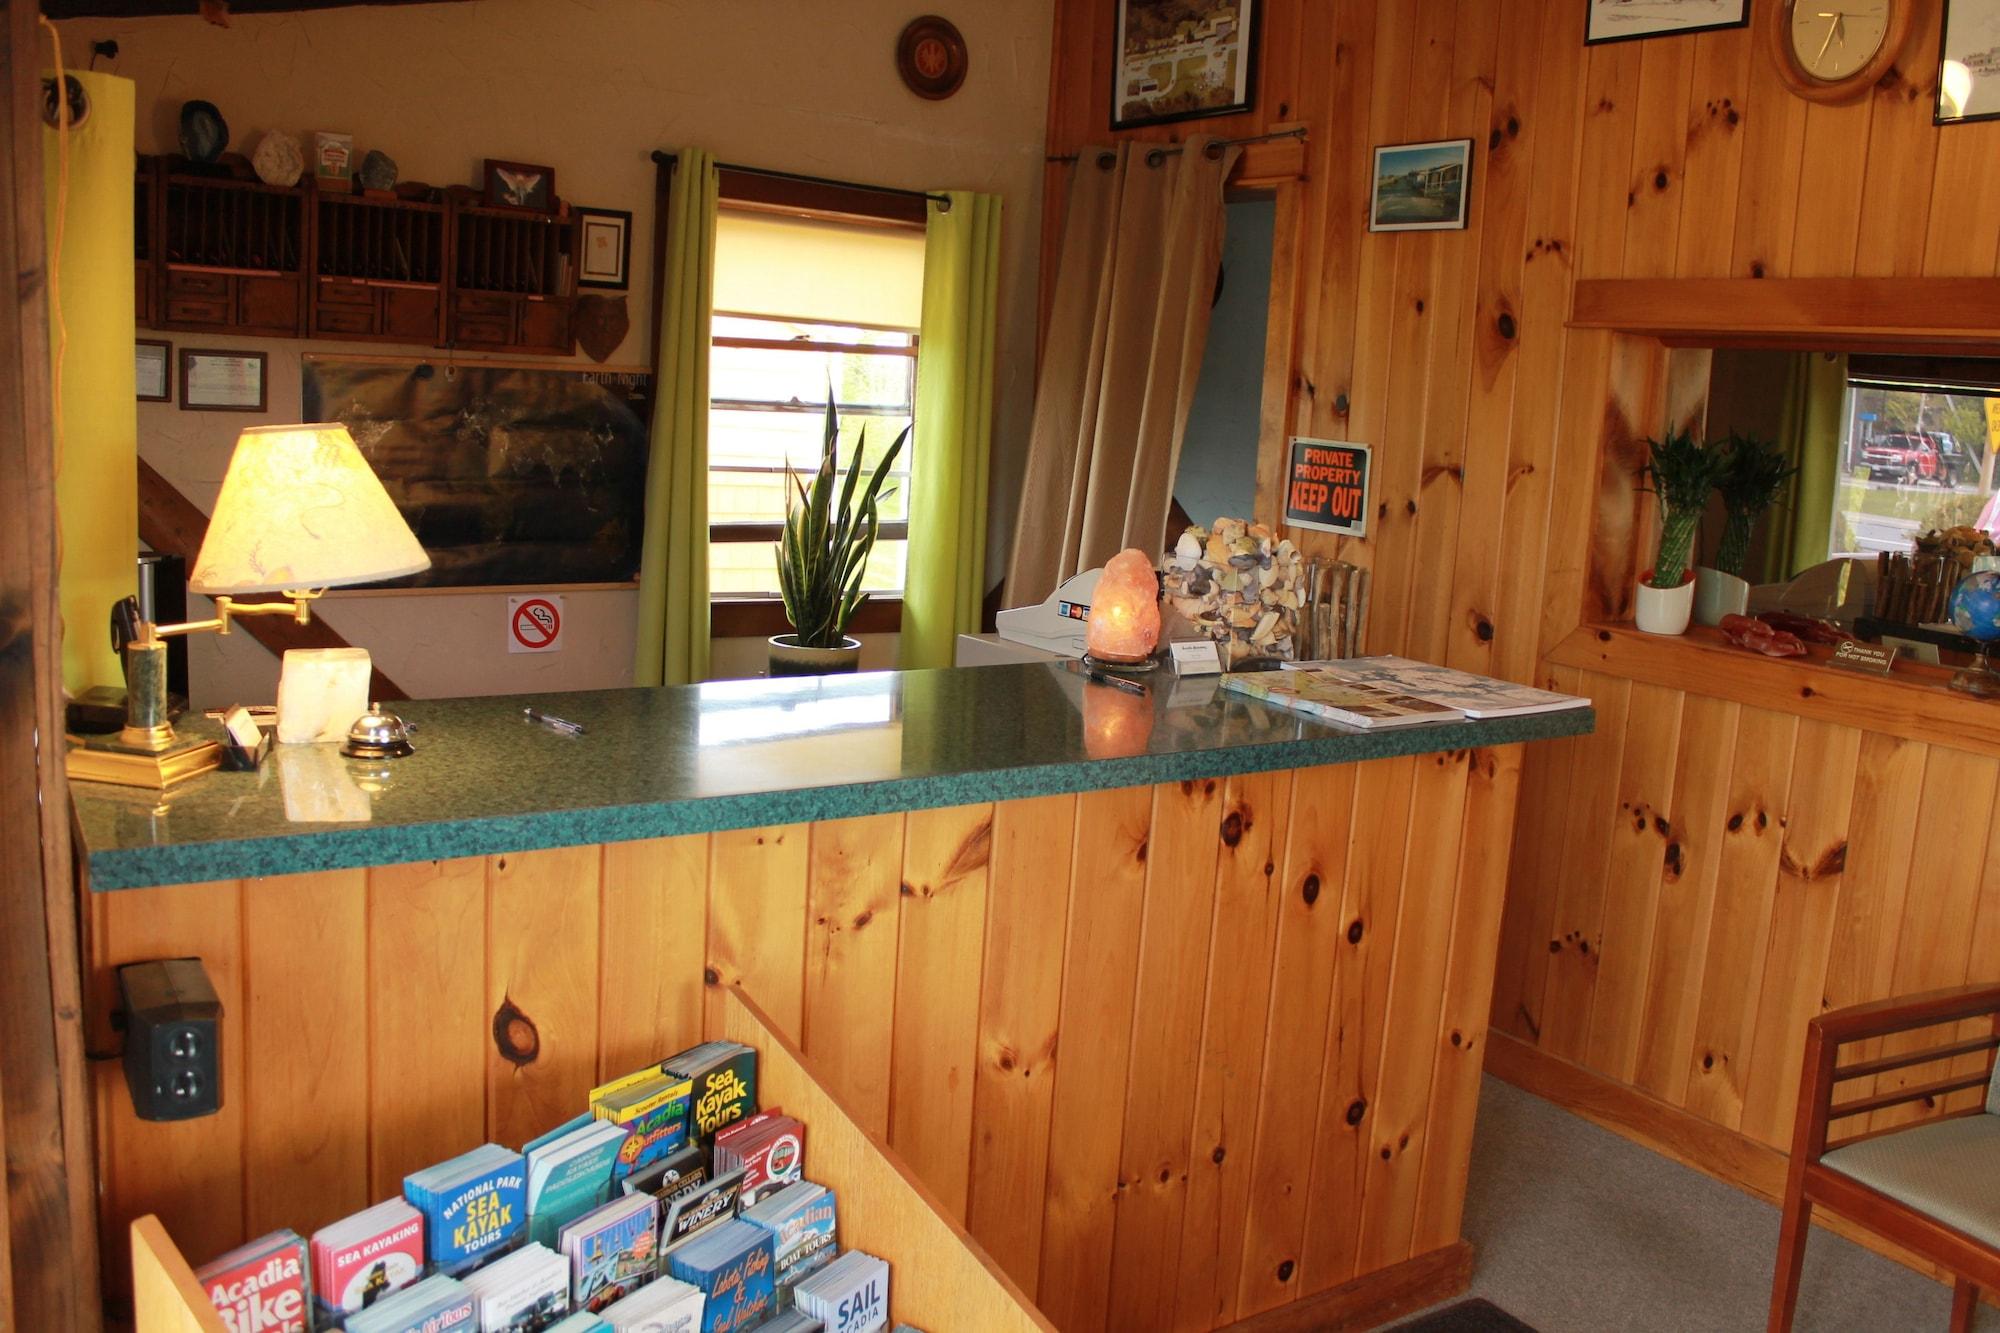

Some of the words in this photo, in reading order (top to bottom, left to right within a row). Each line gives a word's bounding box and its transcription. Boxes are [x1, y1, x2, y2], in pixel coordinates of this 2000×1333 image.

[1295, 463, 1361, 485] PROPERTY
[1304, 448, 1354, 467] PRIVATE
[1290, 481, 1328, 513] KEEP
[1332, 486, 1362, 518] OUT
[1835, 651, 1848, 659] FOR
[1848, 653, 1860, 661] NOT
[1860, 655, 1887, 665] SMOKING
[1853, 647, 1872, 655] THANK
[1873, 650, 1886, 658] YOU
[696, 1077, 747, 1120] Kayak
[706, 1069, 734, 1096] Sea
[637, 1099, 684, 1136] Acadia
[698, 1103, 742, 1137] Tours
[443, 1180, 495, 1220] NATIONAL
[496, 1175, 523, 1190] PARK
[466, 1191, 499, 1222] SEA
[678, 1192, 733, 1233] WINERY
[453, 1203, 512, 1248] KAYAK
[464, 1229, 502, 1254] TOURS
[337, 1250, 362, 1268] SEA
[363, 1222, 419, 1257] KAYAKING
[780, 1247, 801, 1272] BOAT
[804, 1233, 832, 1254] TOURS
[212, 1257, 300, 1306] Acadia
[838, 1280, 880, 1329] SAIL
[840, 1306, 879, 1333] CADIA
